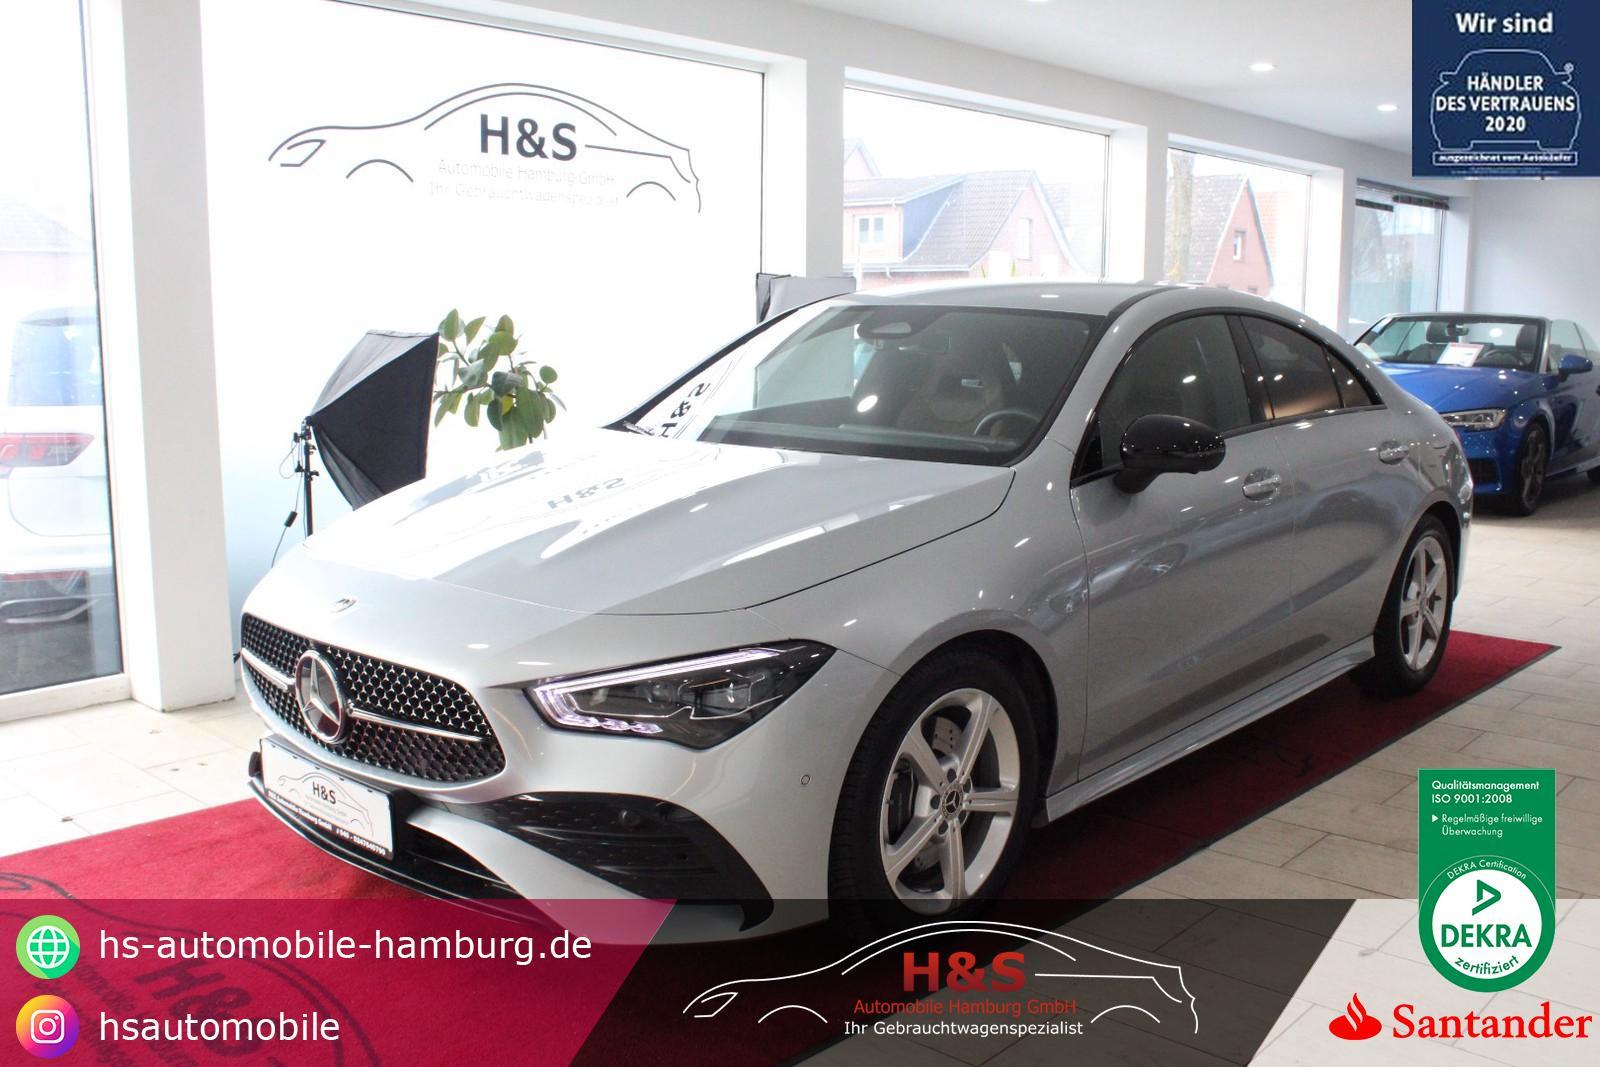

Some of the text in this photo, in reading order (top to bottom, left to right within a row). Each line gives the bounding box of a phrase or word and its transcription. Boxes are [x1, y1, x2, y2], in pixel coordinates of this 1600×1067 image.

[479, 114, 577, 161] H&S
[437, 159, 616, 187] Automobile Hamburg GmbH
[312, 781, 337, 805] H&S
